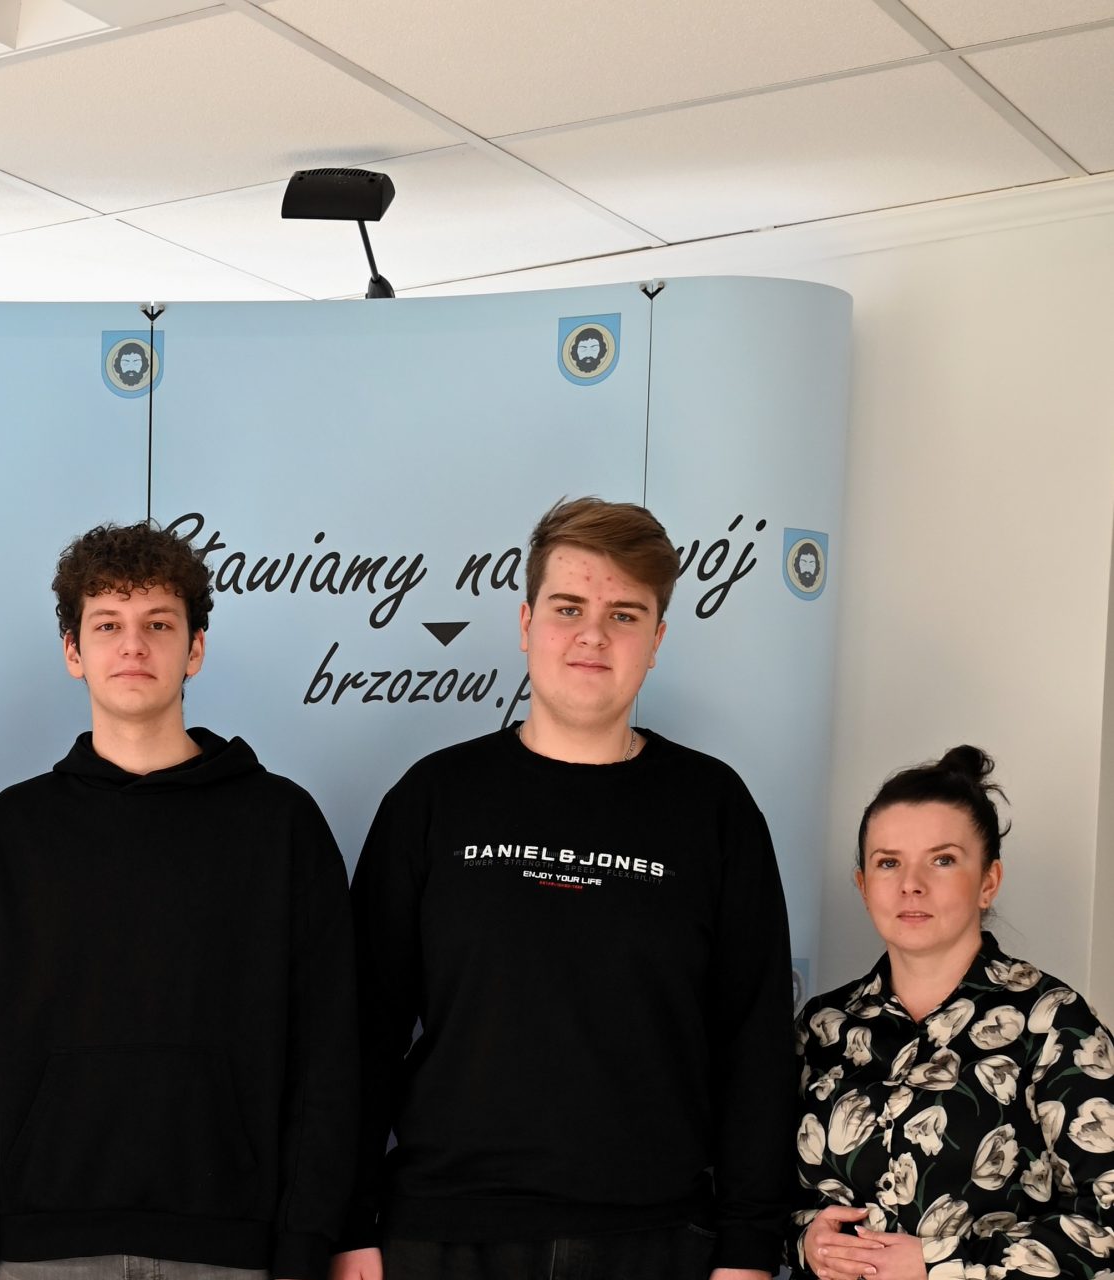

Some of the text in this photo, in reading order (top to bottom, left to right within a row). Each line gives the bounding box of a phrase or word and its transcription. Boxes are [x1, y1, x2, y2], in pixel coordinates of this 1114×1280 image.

[455, 547, 522, 597] na
[303, 641, 531, 729] brzozow.p
[463, 859, 493, 868] POWER
[504, 859, 553, 870] STRENGTH
[564, 865, 596, 874] SPEED
[523, 870, 553, 880] ENJOY
[555, 873, 580, 883] YOUR
[581, 877, 602, 886] LIFE
